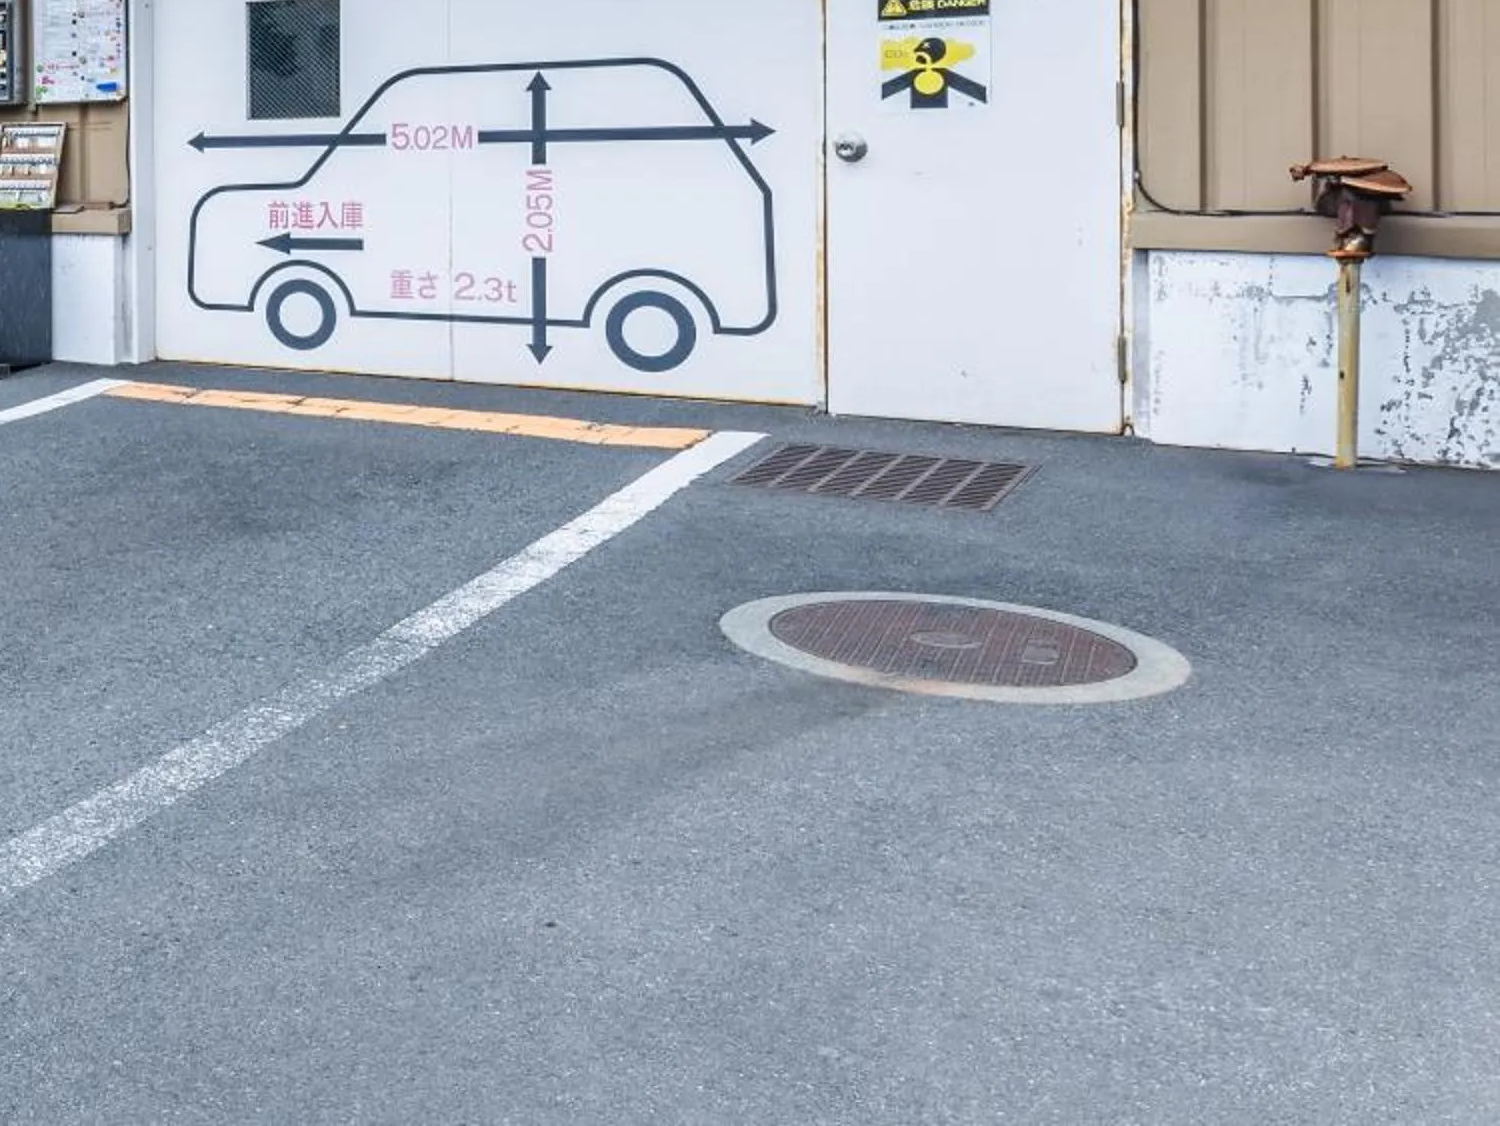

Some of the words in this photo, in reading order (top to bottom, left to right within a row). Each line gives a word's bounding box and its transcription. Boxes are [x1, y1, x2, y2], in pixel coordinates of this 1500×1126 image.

[267, 201, 364, 231] 前進入庫
[522, 168, 554, 254] 2.05M
[389, 270, 438, 301] 重さ
[453, 273, 518, 304] 2.3t
